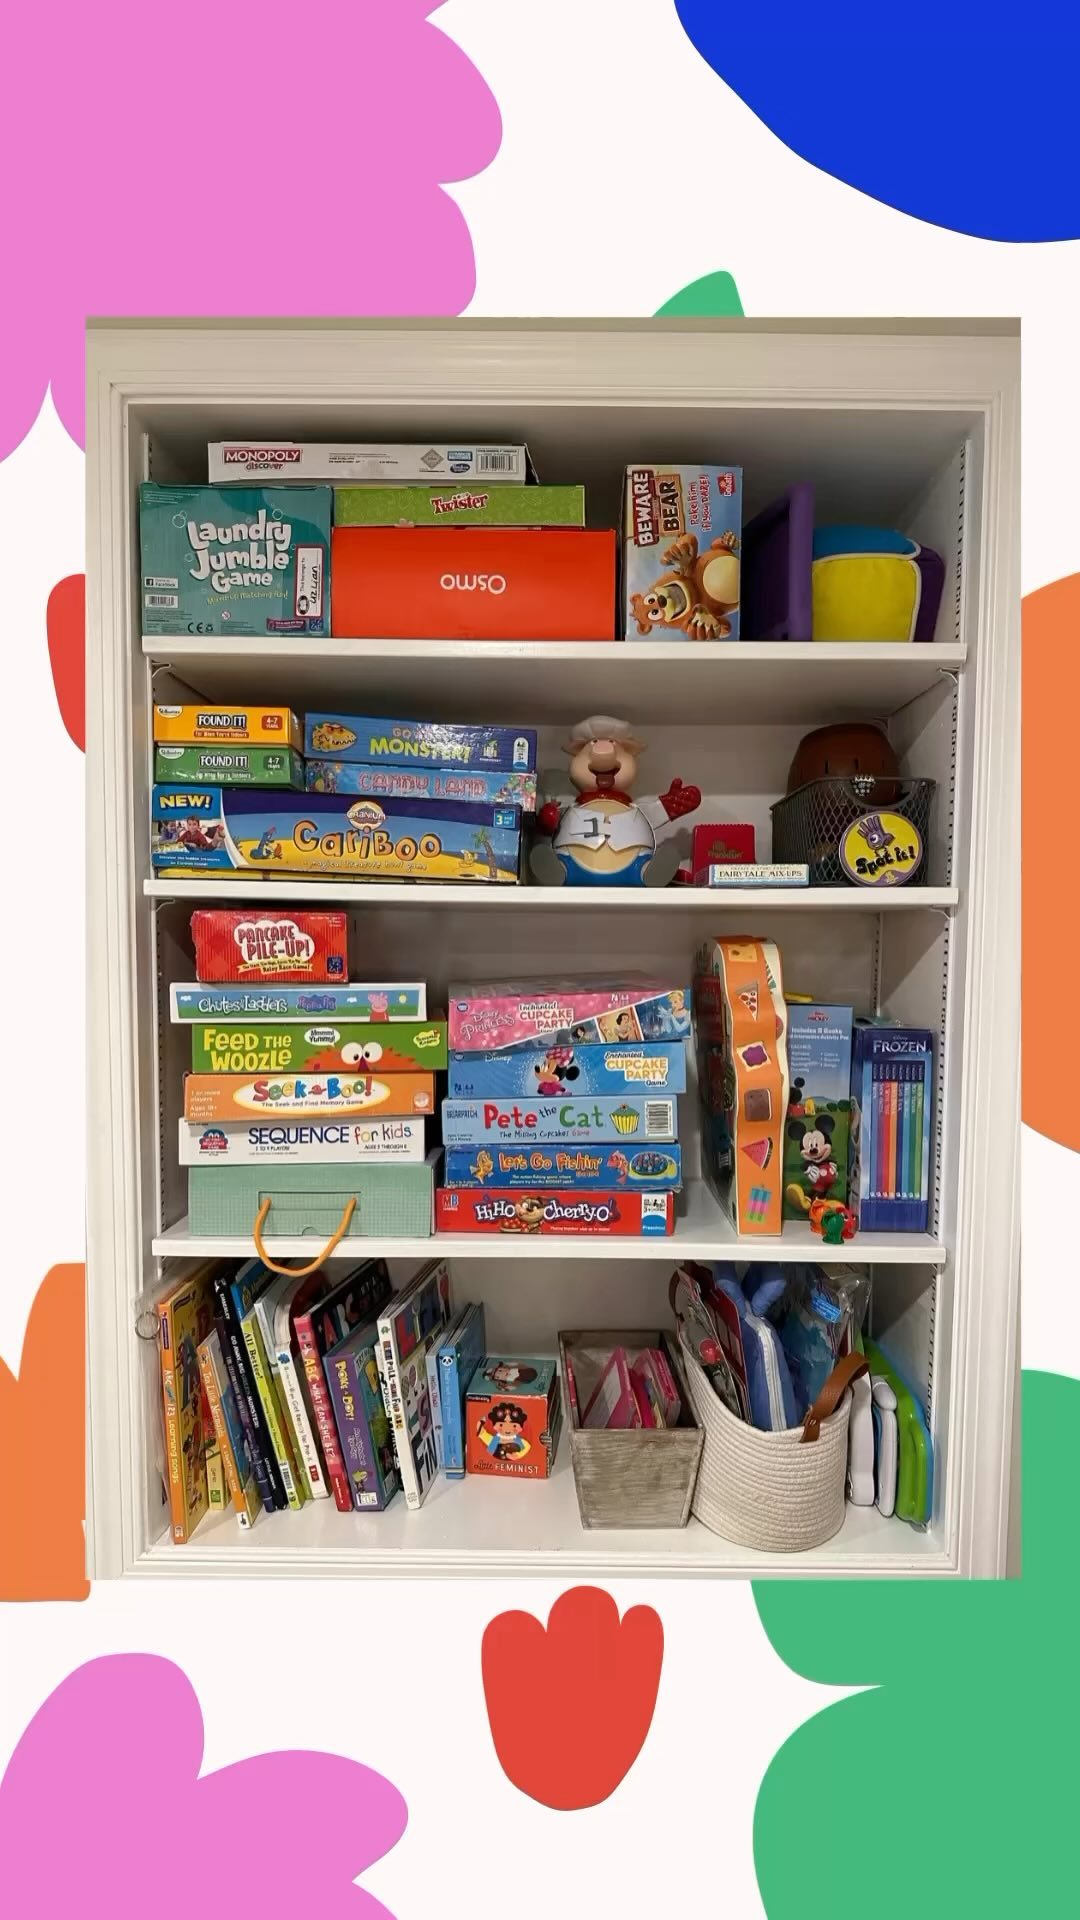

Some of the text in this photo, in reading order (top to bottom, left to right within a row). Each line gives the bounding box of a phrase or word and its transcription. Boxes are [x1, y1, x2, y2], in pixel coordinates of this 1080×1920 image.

[226, 451, 300, 462] MONOPOLY
[246, 462, 283, 470] discover
[700, 474, 710, 504] DARE!
[431, 493, 488, 514] Twister
[633, 472, 654, 544] BEWARE
[659, 481, 680, 531] BEAR
[702, 505, 711, 522] you
[187, 509, 291, 551] Laundry
[189, 540, 290, 580] Jumble
[211, 572, 273, 593] Game
[440, 574, 506, 594] Osmo
[198, 716, 246, 728] FOUND IT!
[370, 736, 472, 763] MONSTER!
[200, 757, 247, 768] FOUND IT!
[268, 757, 279, 765] 4-7
[358, 772, 487, 797] CANDY LAND
[159, 794, 211, 808] NEW!
[496, 815, 503, 825] 3
[856, 845, 915, 875] Spot it!
[719, 870, 765, 878] FAIRYTALE
[237, 925, 296, 943] PANCAKE
[246, 939, 310, 961] PILE-UP!
[199, 995, 288, 1013] Chutes Ladders
[519, 1002, 558, 1011] Enchanted
[520, 1009, 573, 1020] CUPCAKE
[537, 1019, 572, 1029] PARTY
[605, 1051, 642, 1059] Enchanted
[872, 1040, 927, 1054] FROZEN
[485, 1053, 513, 1063] Disney
[607, 1059, 667, 1069] CUPCAKE
[626, 1070, 666, 1080] PARTY
[253, 1075, 373, 1102] Seek-a-Boo!
[483, 1103, 604, 1129] Pete the Cat
[248, 1123, 412, 1145] SEQUENCE for kids
[514, 1130, 537, 1140] Missing
[539, 1130, 569, 1139] Cupcakes
[571, 1129, 590, 1137] Game
[498, 1152, 603, 1172] Let's Go Fishin'
[218, 1292, 231, 1320] EMBERLEY
[242, 1330, 264, 1380] All Better!
[163, 1369, 173, 1385] ABC
[229, 1334, 238, 1345] GO
[236, 1362, 246, 1374] BIG
[245, 1394, 260, 1429] MONSTER!
[334, 1359, 357, 1421] POKE DOT!
[201, 1371, 227, 1438] Ten Little Mermaids
[303, 1356, 336, 1459] ABC WHAT CAN SHE BE?
[166, 1402, 180, 1484] 123 Learning songs
[495, 1463, 539, 1474] FEMINIST
